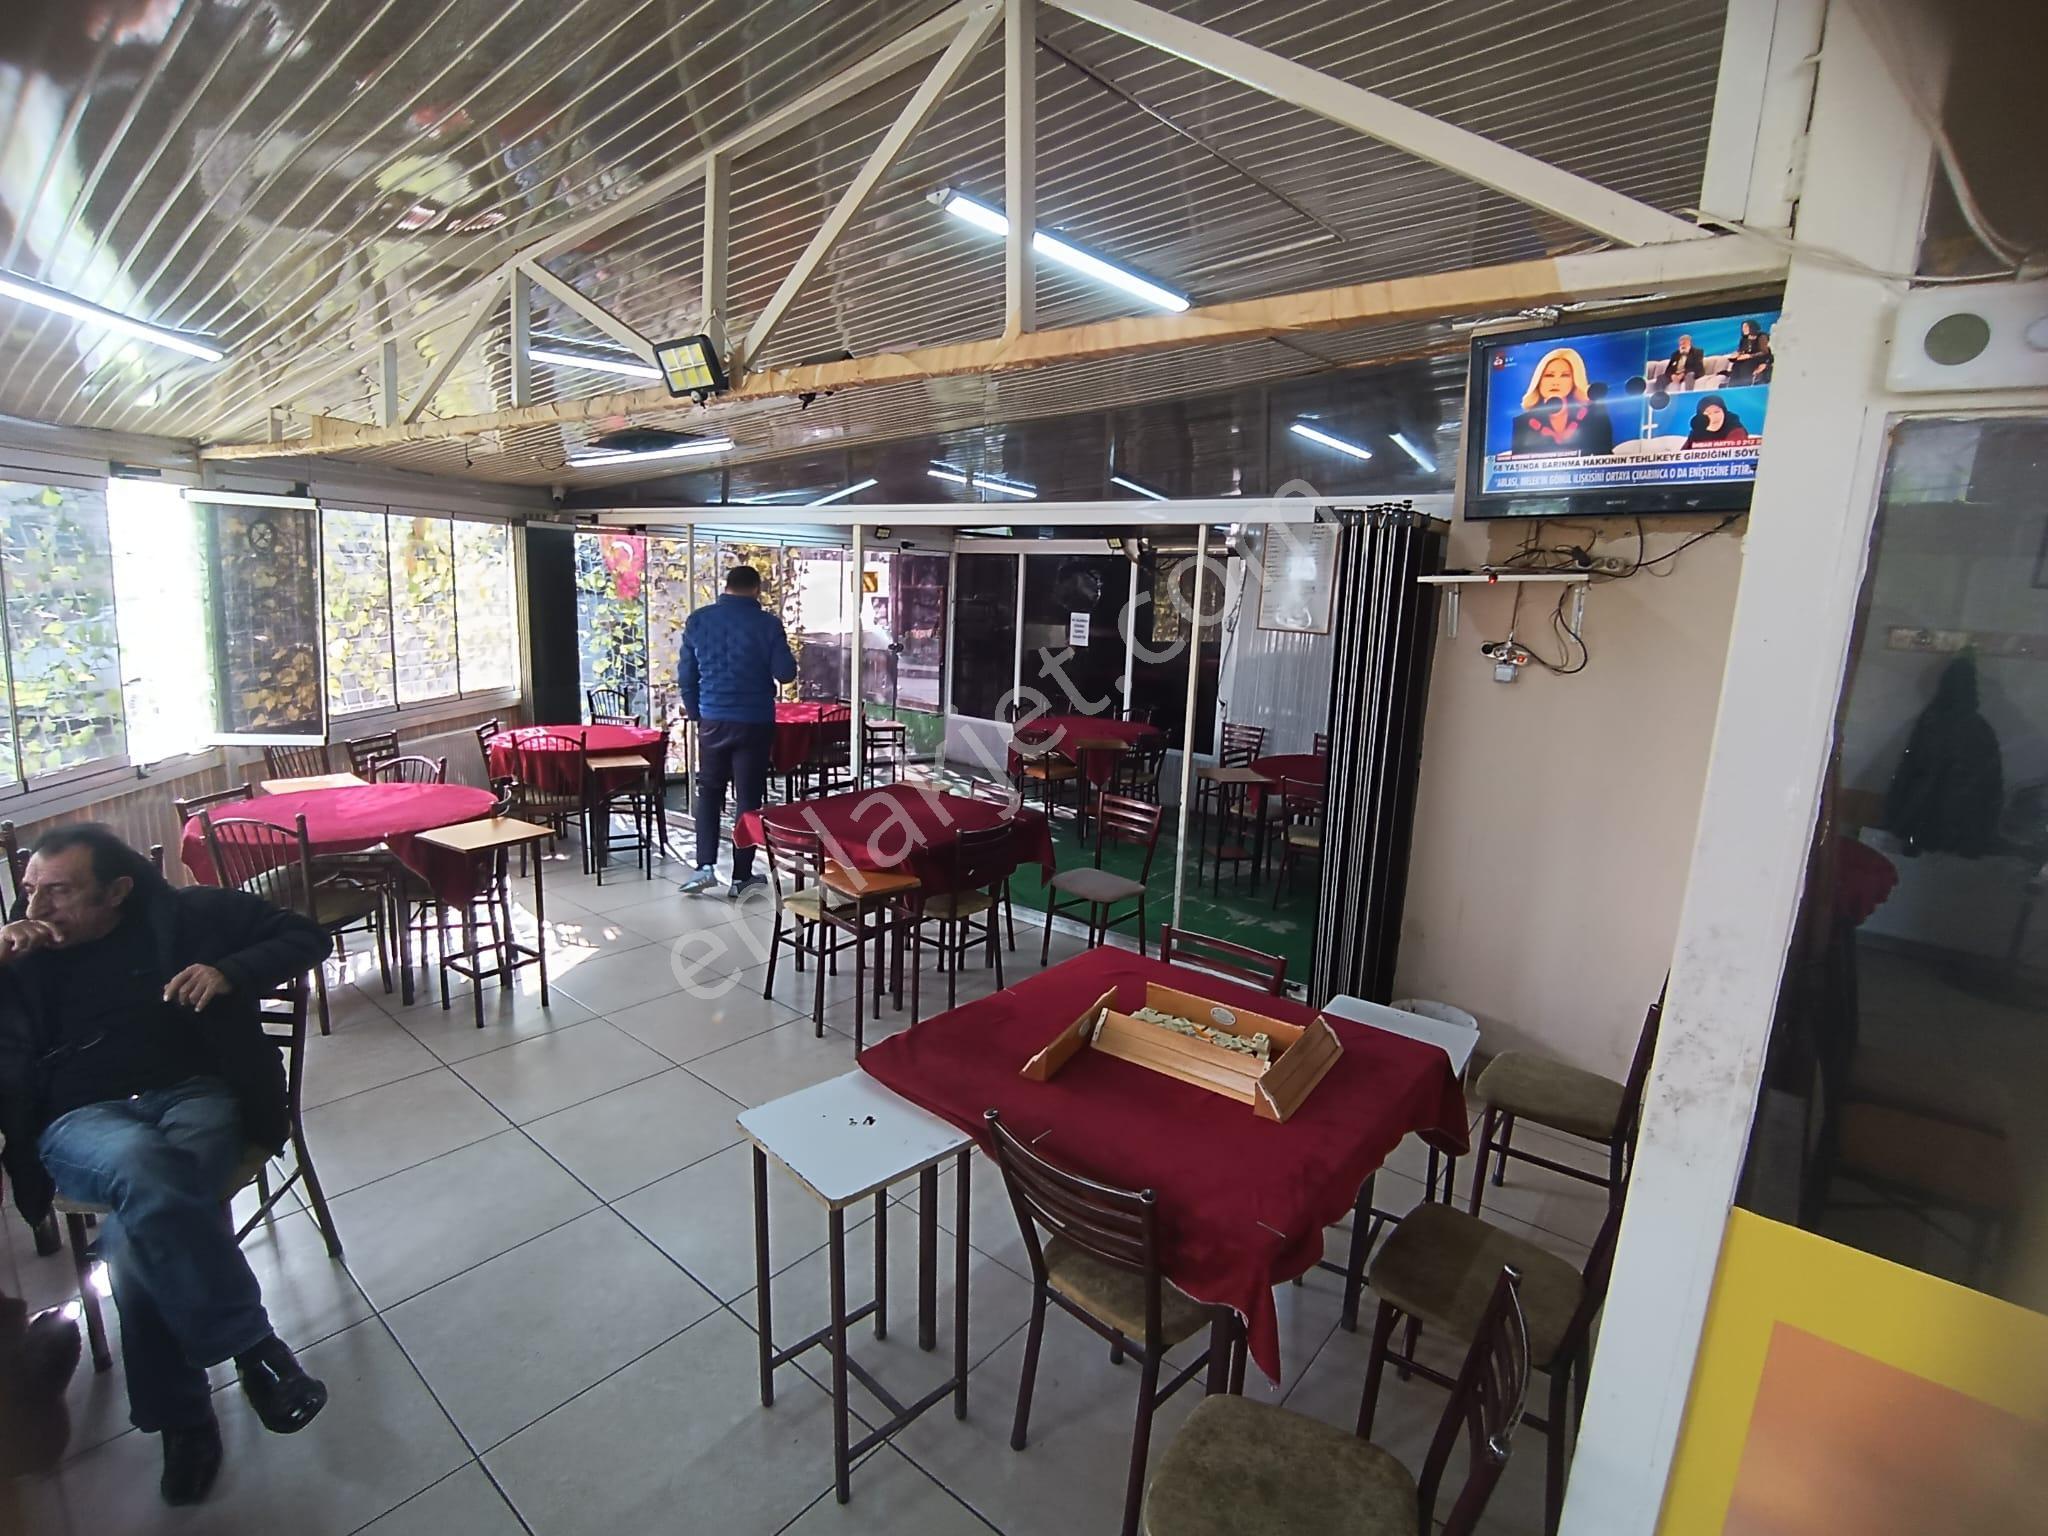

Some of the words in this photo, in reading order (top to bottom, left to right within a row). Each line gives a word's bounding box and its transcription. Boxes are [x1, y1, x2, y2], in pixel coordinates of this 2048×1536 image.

[1583, 456, 1627, 466] HAKKININ
[1630, 452, 1681, 464] TEHLİKEYE
[1683, 449, 1732, 461] GİRDİĞİNİ
[1605, 470, 1631, 482] ORTAYA
[1632, 468, 1668, 483] ÇIKARINCA
[1669, 467, 1676, 478] O
[1677, 466, 1687, 478] DA
[1688, 463, 1728, 480] ENİŞTESİNE
